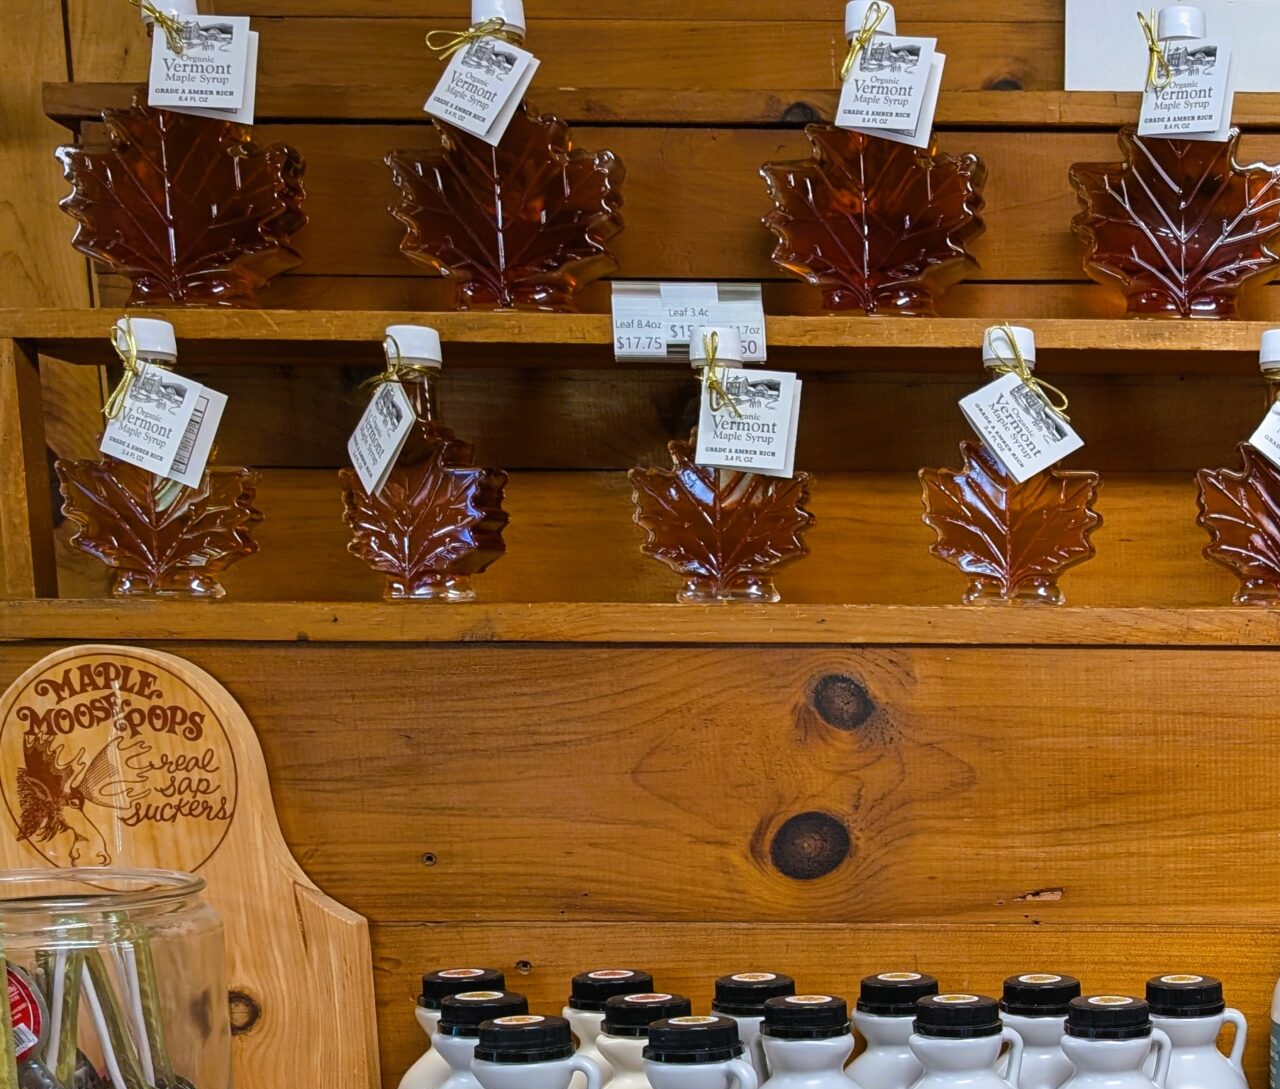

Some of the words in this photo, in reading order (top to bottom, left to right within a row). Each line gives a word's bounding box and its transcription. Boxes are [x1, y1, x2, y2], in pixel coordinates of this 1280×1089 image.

[162, 58, 232, 75] Vermont
[181, 54, 215, 64] Organic
[165, 73, 196, 85] Maple
[200, 74, 229, 86] Syrup
[155, 88, 179, 96] GRADE
[188, 88, 213, 96] AMBER
[215, 88, 234, 97] RICH
[615, 320, 632, 329] Leaf
[636, 320, 661, 330] 8.4oz
[616, 336, 661, 353] $17.75
[712, 415, 776, 433] Vermont
[728, 412, 761, 423] Organic
[713, 431, 742, 443] Maple
[746, 433, 773, 445] Syrup
[35, 662, 162, 705] MAPLE
[16, 692, 125, 737] MOOSE
[114, 705, 205, 741] POPS
[149, 748, 220, 775] real
[153, 776, 220, 799] sap
[117, 796, 233, 827] suckers
